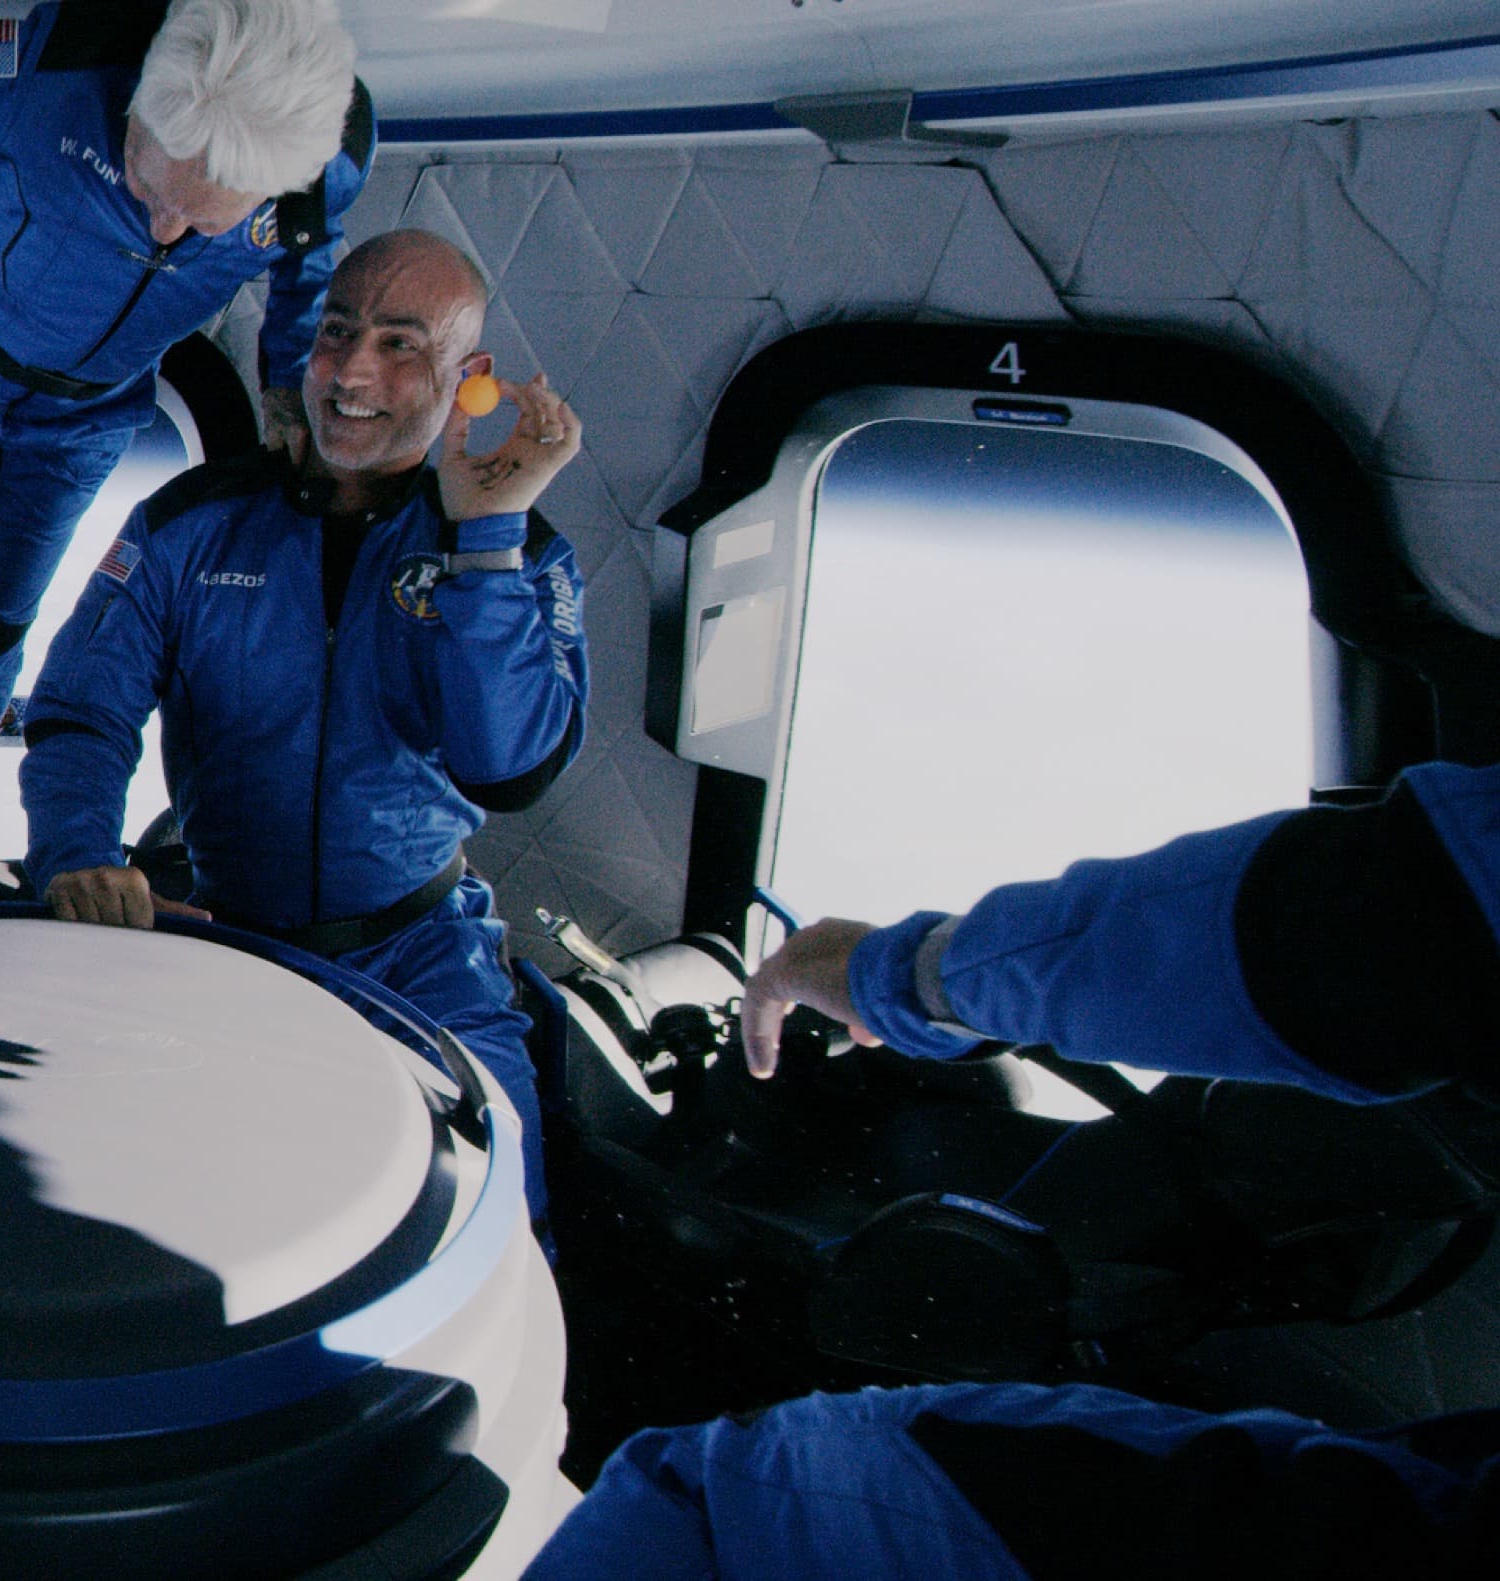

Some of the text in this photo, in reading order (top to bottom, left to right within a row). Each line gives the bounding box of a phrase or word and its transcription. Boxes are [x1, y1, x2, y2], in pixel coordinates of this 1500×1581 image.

[82, 146, 124, 185] FUN
[989, 341, 1027, 384] 4
[209, 572, 267, 588] BEZOS
